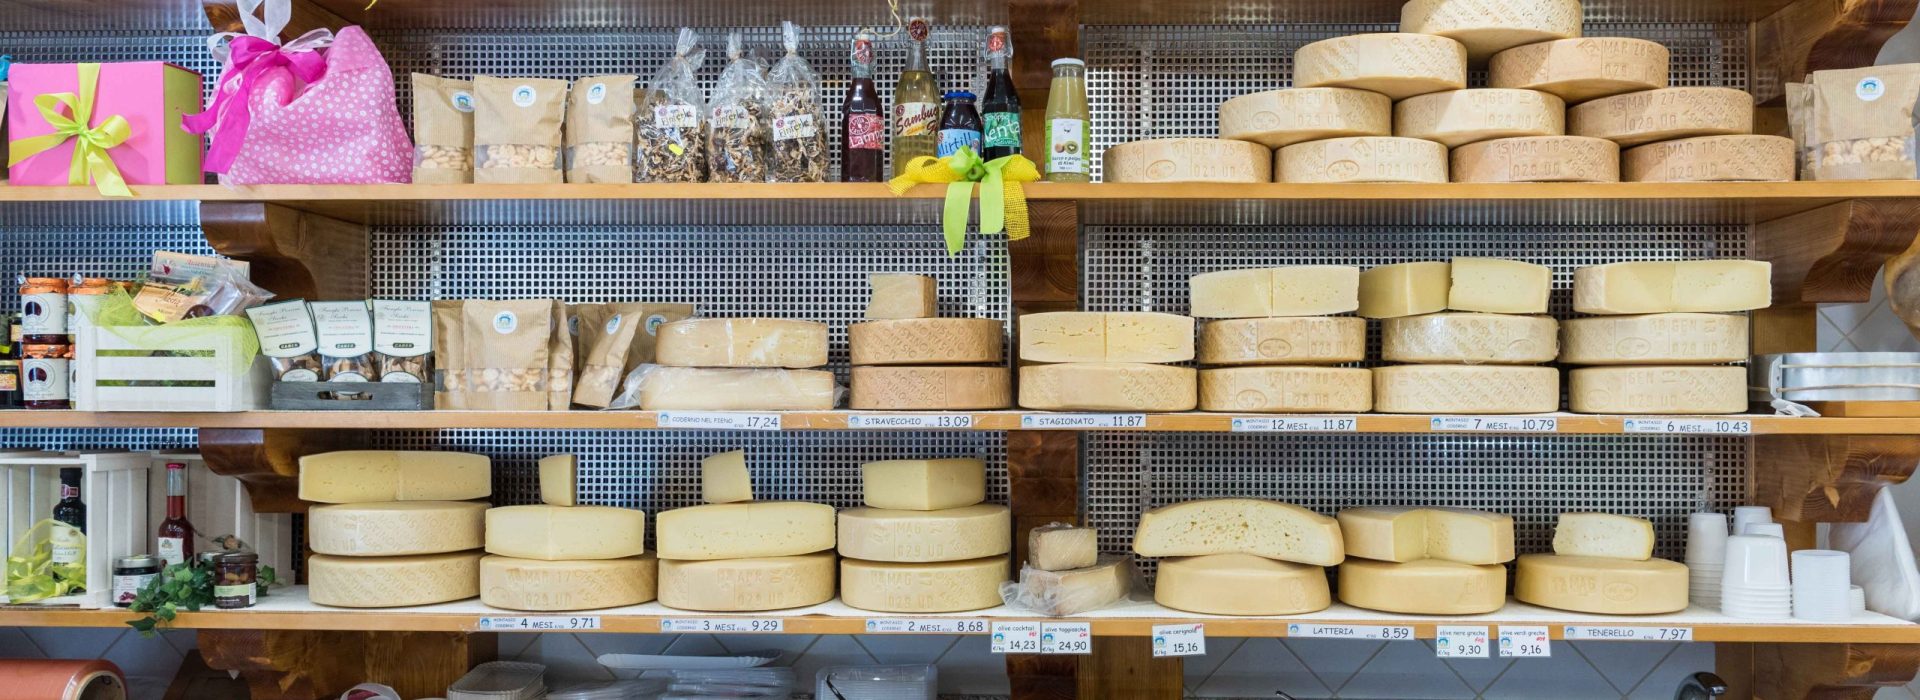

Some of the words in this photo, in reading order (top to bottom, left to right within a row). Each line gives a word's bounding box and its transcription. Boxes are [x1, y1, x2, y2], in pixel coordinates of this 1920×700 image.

[701, 416, 712, 424] NEL
[713, 417, 733, 425] FIENO
[747, 416, 778, 430] 17,24
[864, 418, 922, 426] STRAVECCHIO
[937, 416, 969, 429] 13,09
[1039, 417, 1095, 426] STAGIONATO
[1112, 415, 1143, 428] 11,87
[1271, 419, 1285, 431] 12
[1286, 422, 1308, 431] MESI
[1323, 419, 1353, 432] 11,87
[1473, 418, 1482, 430] 7
[1486, 422, 1509, 430] MESI
[1522, 419, 1555, 431] 10,79
[1667, 421, 1675, 432] 6
[1679, 424, 1701, 433] MESI
[1716, 421, 1748, 434] 10,43
[520, 617, 528, 629] 4
[532, 621, 554, 629] MESI
[570, 617, 594, 630] 9,71
[703, 620, 710, 631] 3
[714, 623, 736, 631] MESI
[751, 620, 778, 632] 9,29
[908, 621, 915, 632] 2
[919, 624, 941, 632] MESI
[957, 621, 983, 633] 8,68
[997, 624, 1011, 632] olive
[1012, 624, 1035, 632] cocktail
[1044, 626, 1057, 634] olive
[1313, 626, 1354, 636] LATTERIA
[1382, 627, 1409, 639] 8,59
[1587, 629, 1635, 638] TENERELLO
[1659, 628, 1688, 641] 7,97
[1010, 640, 1036, 652] 14,23
[1058, 641, 1087, 652] 24,90
[1173, 642, 1199, 654] 15,16
[1458, 645, 1481, 656] 9,30
[1520, 644, 1542, 656] 9,16
